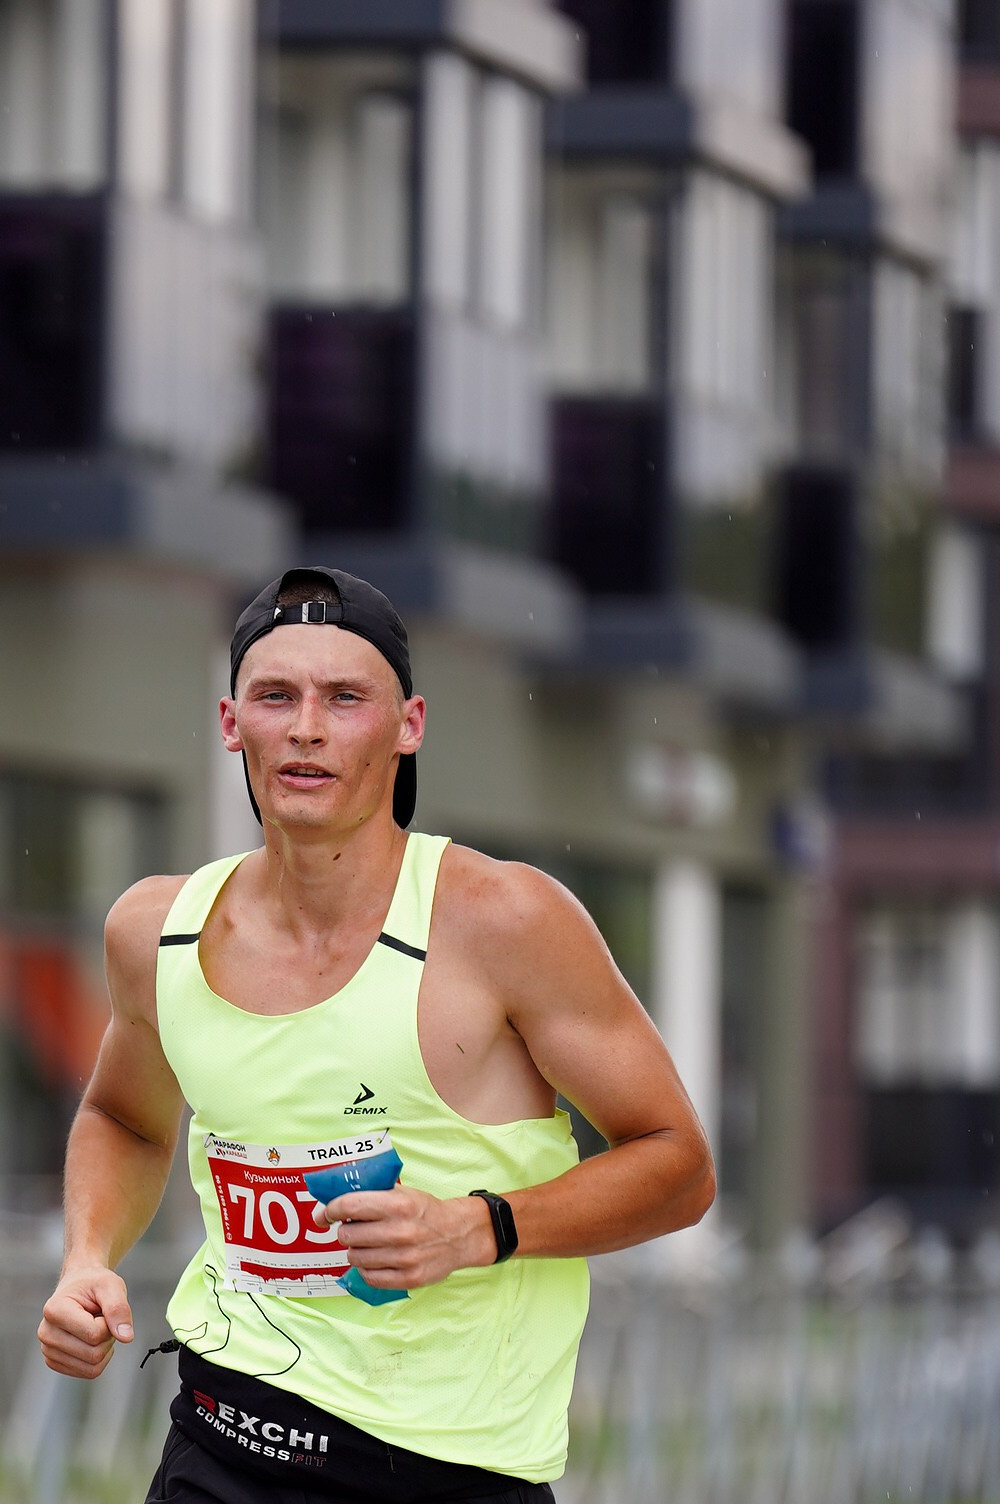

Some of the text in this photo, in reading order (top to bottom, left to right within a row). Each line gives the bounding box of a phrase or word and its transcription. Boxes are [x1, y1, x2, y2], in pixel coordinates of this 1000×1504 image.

[343, 1107, 388, 1115] DEMIX
[213, 1139, 246, 1152] МАРАФОН
[308, 1140, 374, 1161] TRAIL 25
[243, 1170, 301, 1184] Кузьминых
[193, 1389, 328, 1453] REXCHI
